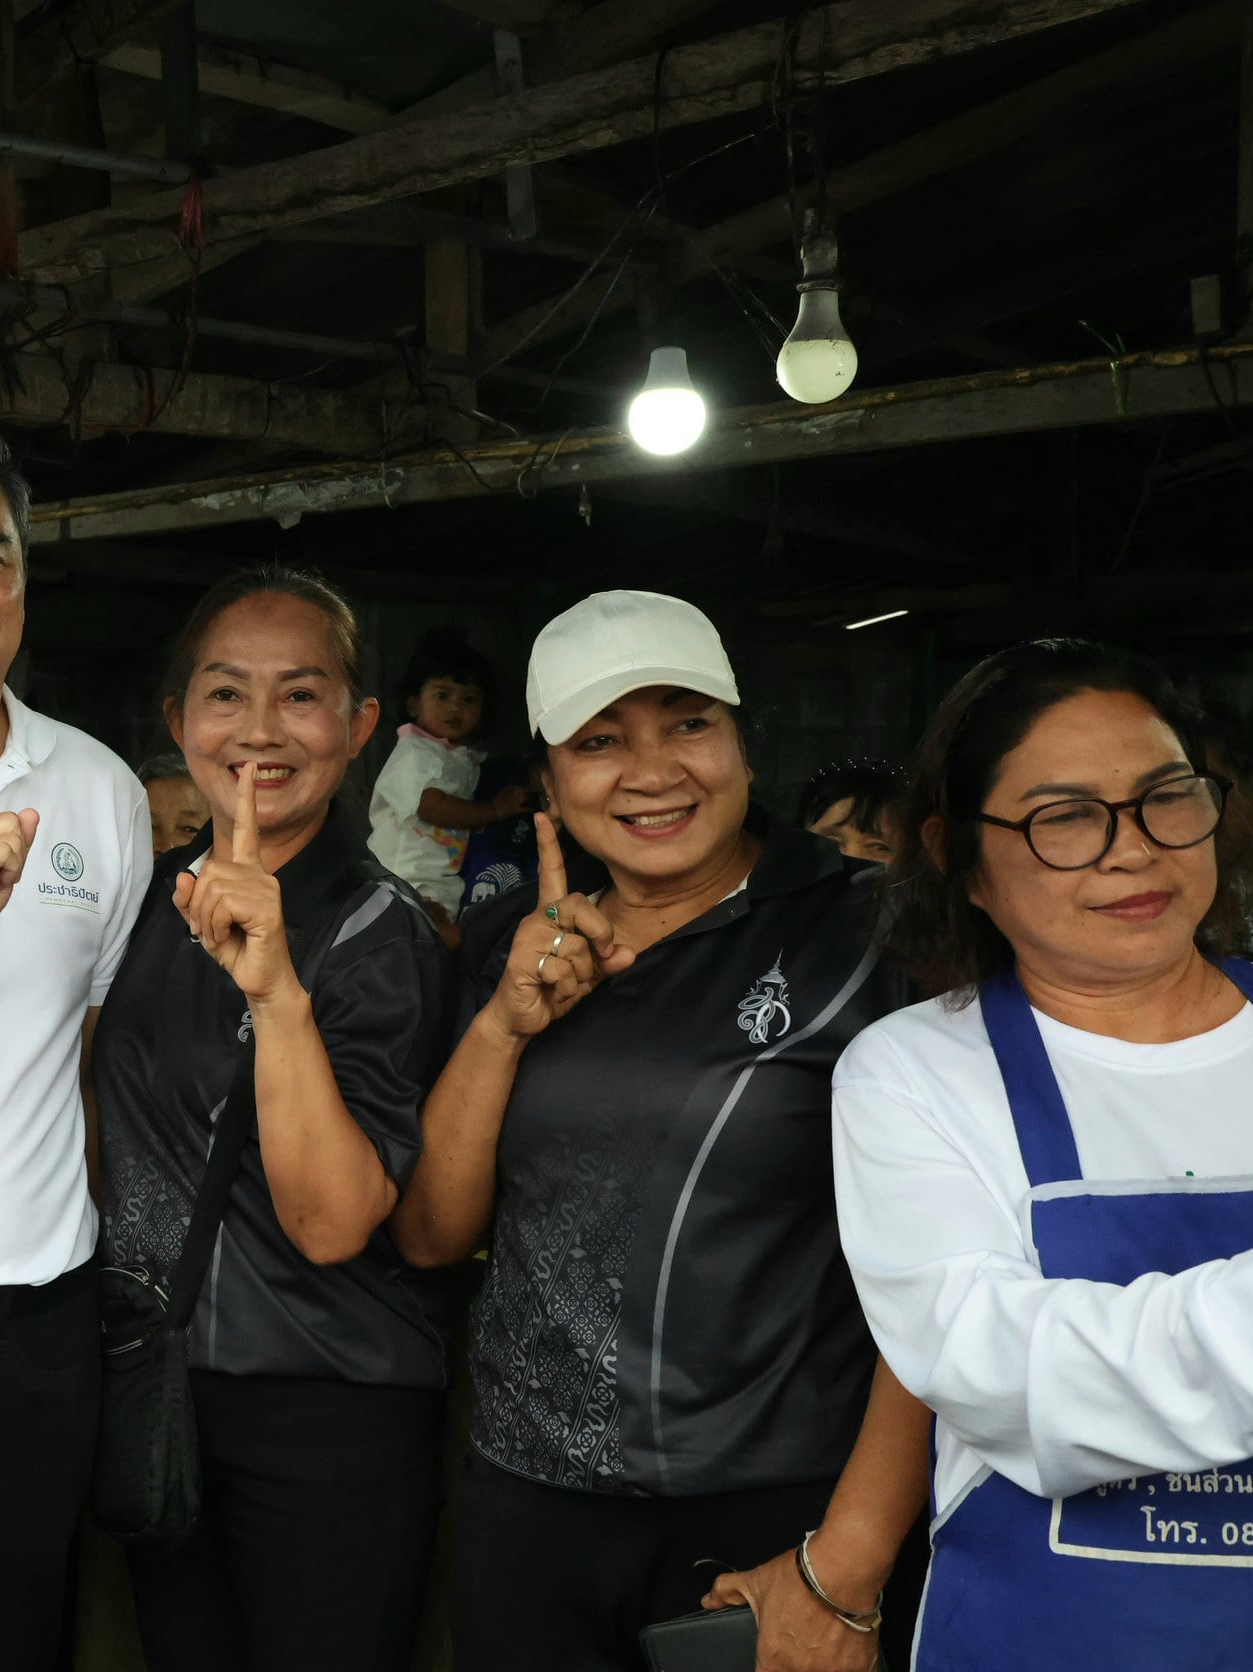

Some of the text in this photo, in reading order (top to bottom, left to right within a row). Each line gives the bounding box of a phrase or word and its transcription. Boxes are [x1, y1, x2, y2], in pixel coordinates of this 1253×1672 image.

[38, 882, 100, 903] ประชาธิปัตย์
[1140, 1505, 1207, 1545] โทร.
